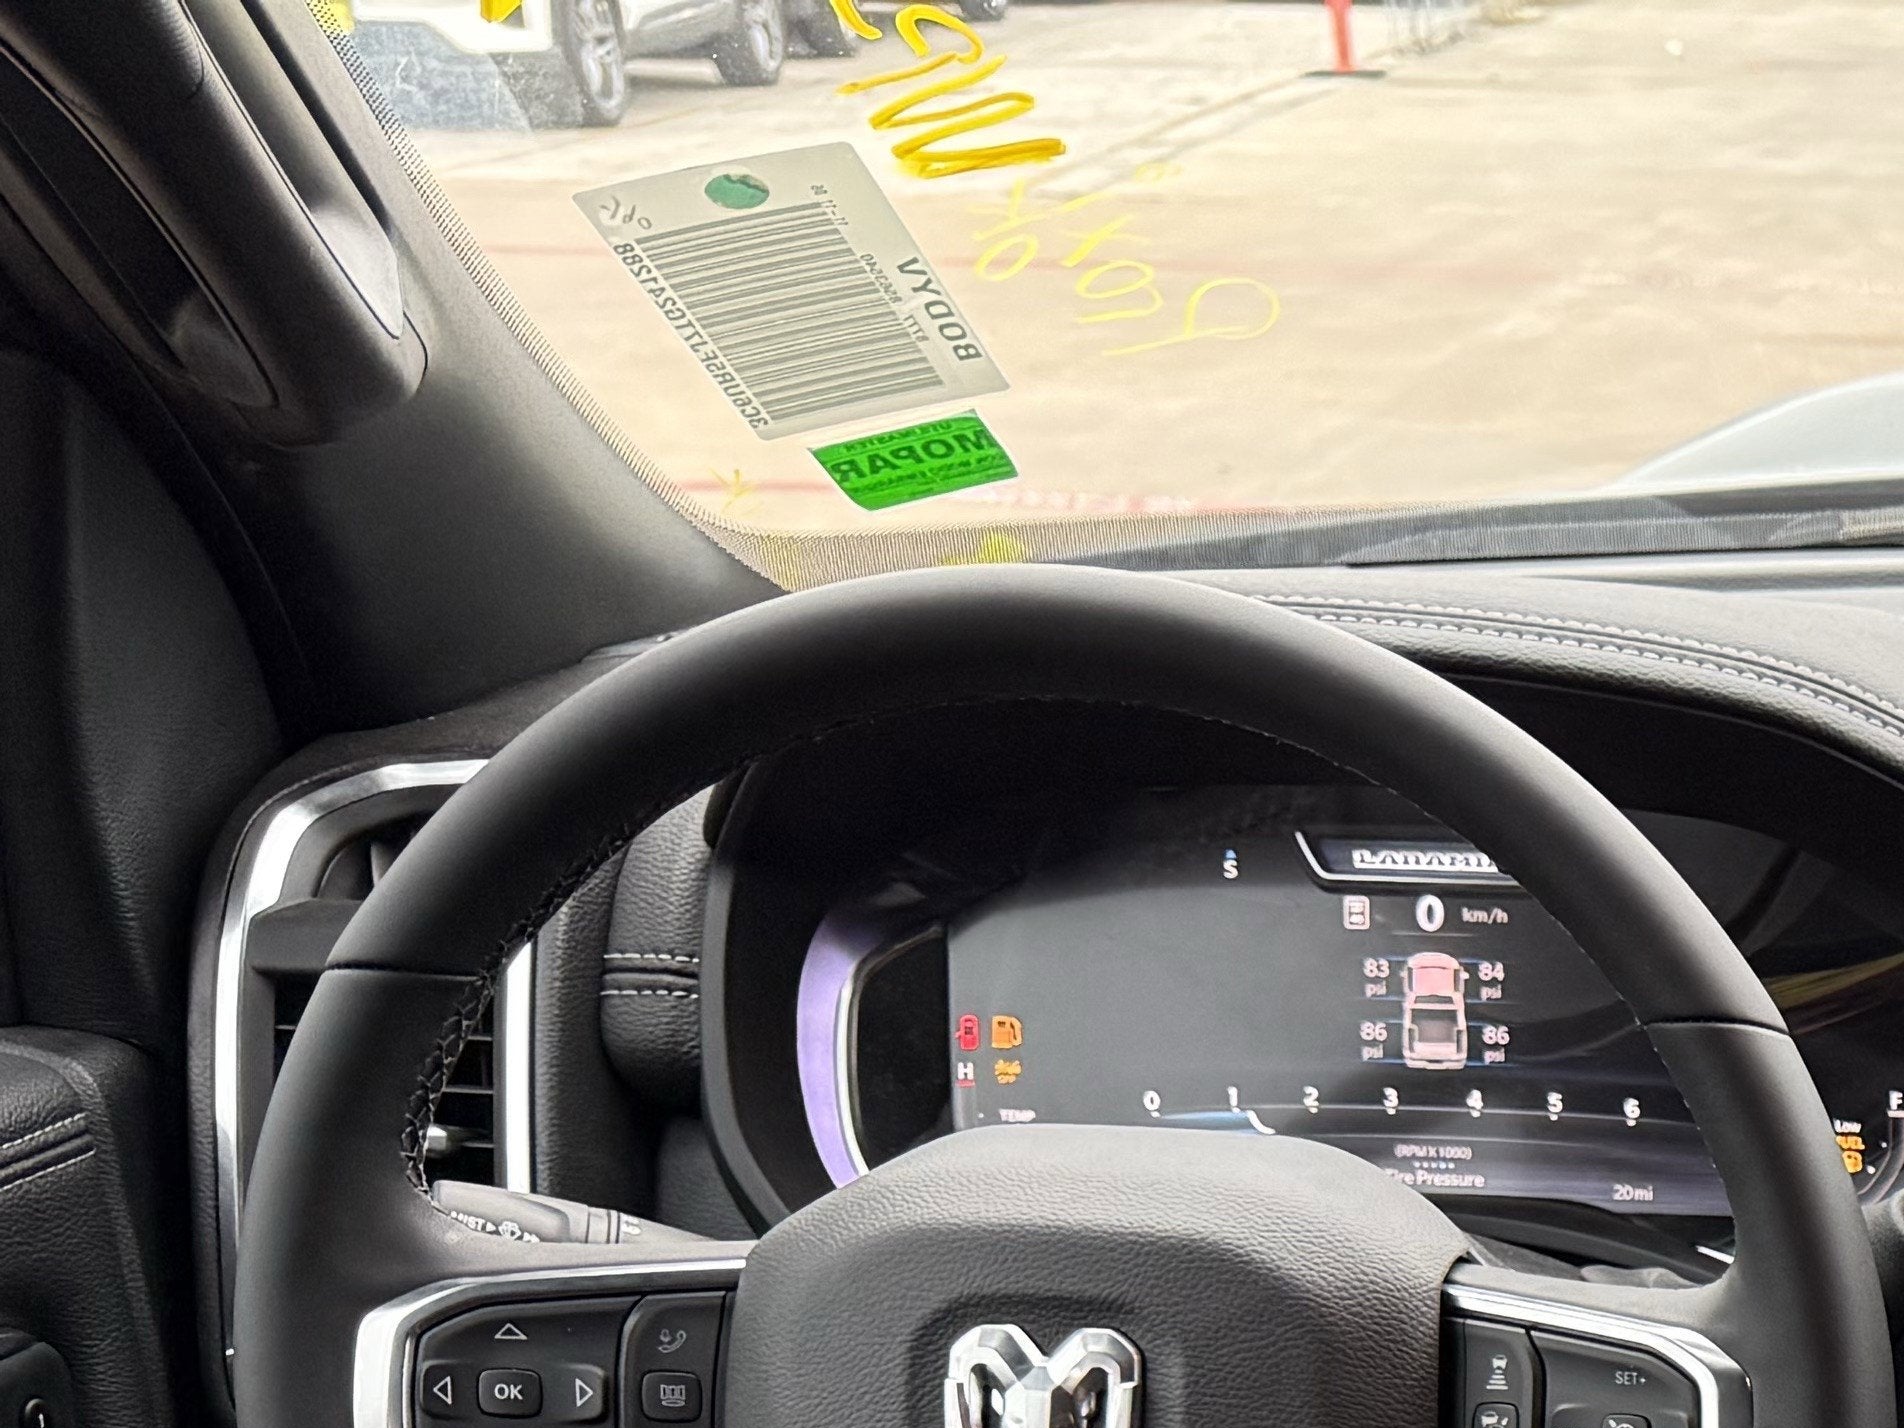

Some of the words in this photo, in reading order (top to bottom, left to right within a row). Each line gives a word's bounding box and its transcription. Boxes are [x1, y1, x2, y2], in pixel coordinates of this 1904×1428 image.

[1223, 859, 1238, 879] S
[1416, 894, 1444, 932] 0
[1462, 907, 1508, 923] km/h
[1363, 958, 1390, 977] 83
[1478, 962, 1505, 981] 84
[1365, 981, 1387, 997] psi
[1481, 985, 1502, 1001] psi
[1360, 1022, 1388, 1041] 86
[1482, 1026, 1510, 1045] 86
[1362, 1044, 1383, 1060] psi
[1484, 1048, 1505, 1064] psi
[957, 1062, 974, 1080] H
[1143, 1091, 1161, 1111] 0
[1227, 1086, 1238, 1106] 1
[1303, 1086, 1320, 1109] 2
[1383, 1087, 1398, 1108] 3
[1466, 1089, 1483, 1110] 4
[1547, 1092, 1563, 1113] 5
[1624, 1097, 1640, 1119] 6
[1889, 1090, 1903, 1110] F
[1416, 1170, 1485, 1187] Pressure
[495, 1384, 523, 1400] OK
